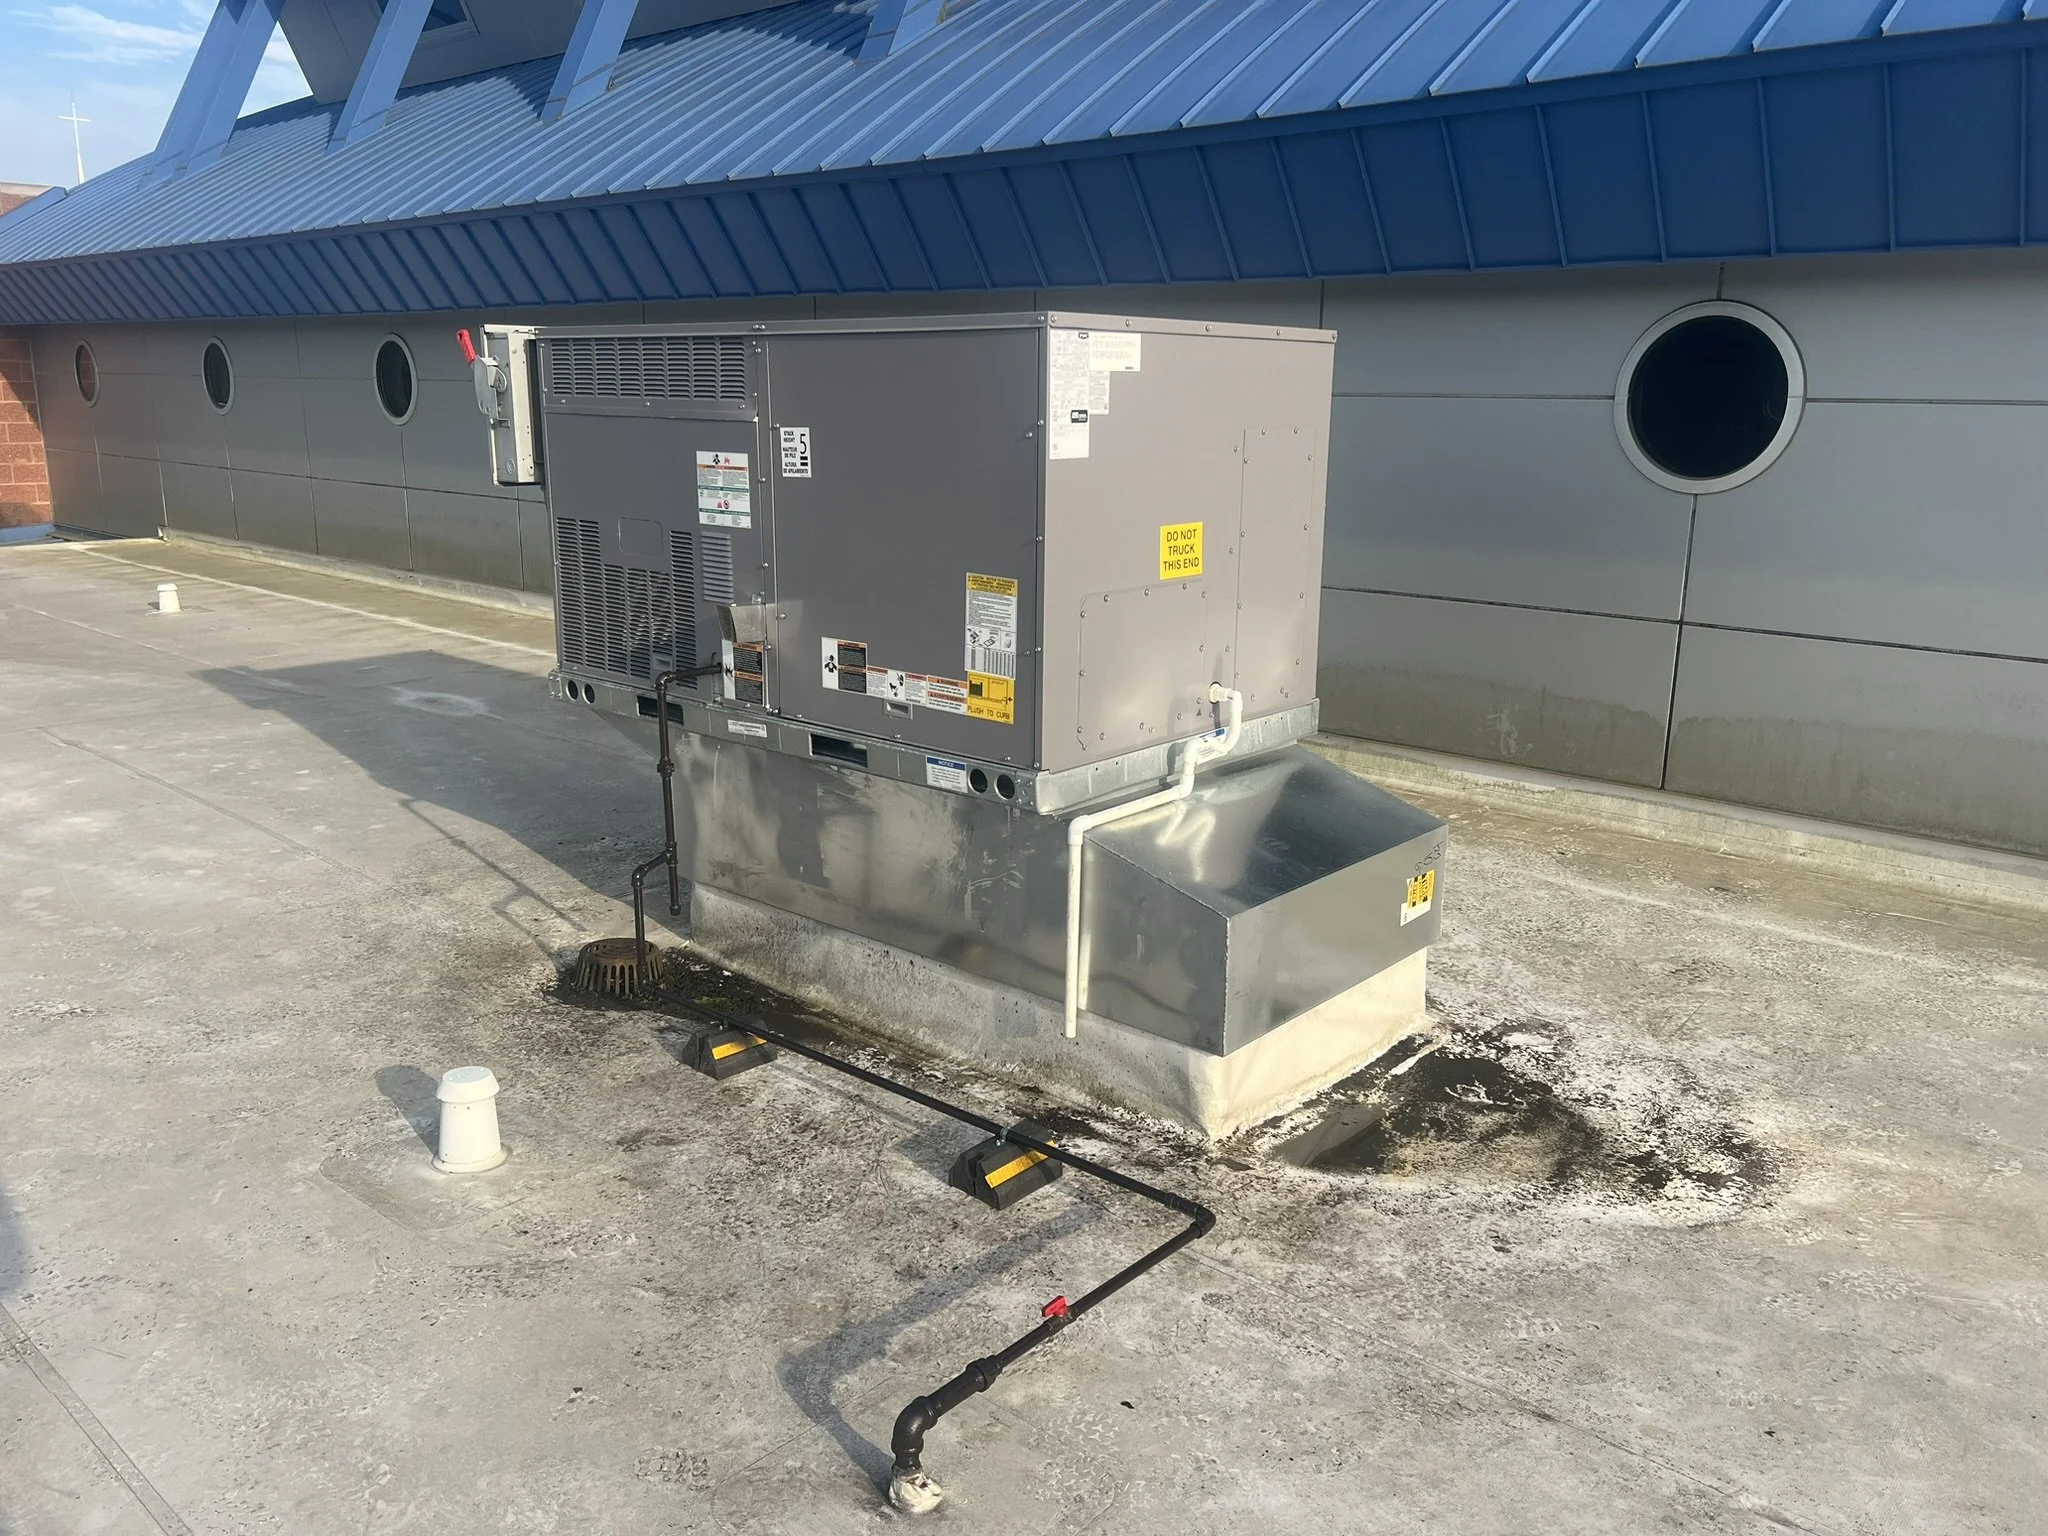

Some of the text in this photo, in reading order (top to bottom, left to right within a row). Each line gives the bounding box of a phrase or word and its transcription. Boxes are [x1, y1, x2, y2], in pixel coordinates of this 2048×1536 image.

[800, 433, 807, 454] 5
[1166, 529, 1197, 542] DO NOT
[1168, 544, 1195, 556] TRUCK
[1163, 557, 1199, 572] THIS END
[968, 706, 984, 715] FLUSH
